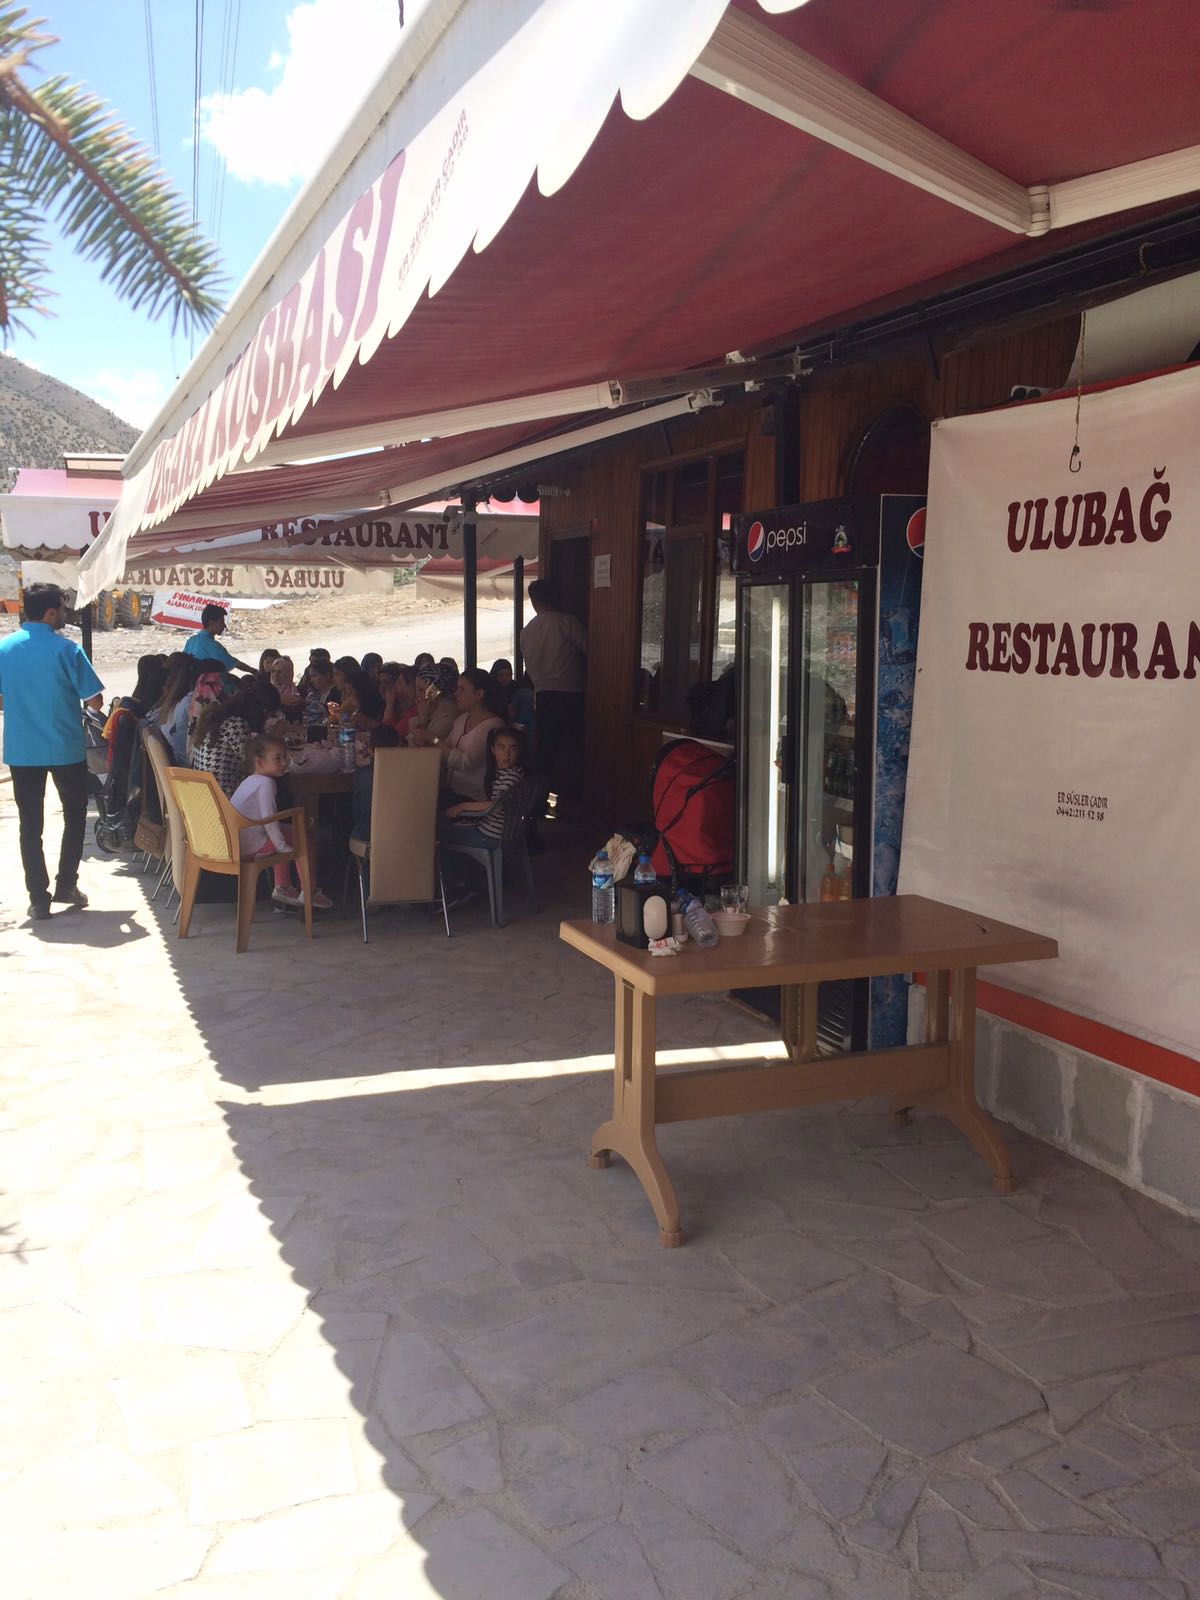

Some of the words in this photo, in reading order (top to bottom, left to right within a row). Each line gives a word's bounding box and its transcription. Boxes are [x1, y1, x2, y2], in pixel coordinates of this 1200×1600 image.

[1007, 465, 1172, 553] ULUBAĞ
[766, 520, 807, 554] pepsi
[1057, 791, 1065, 803] ER
